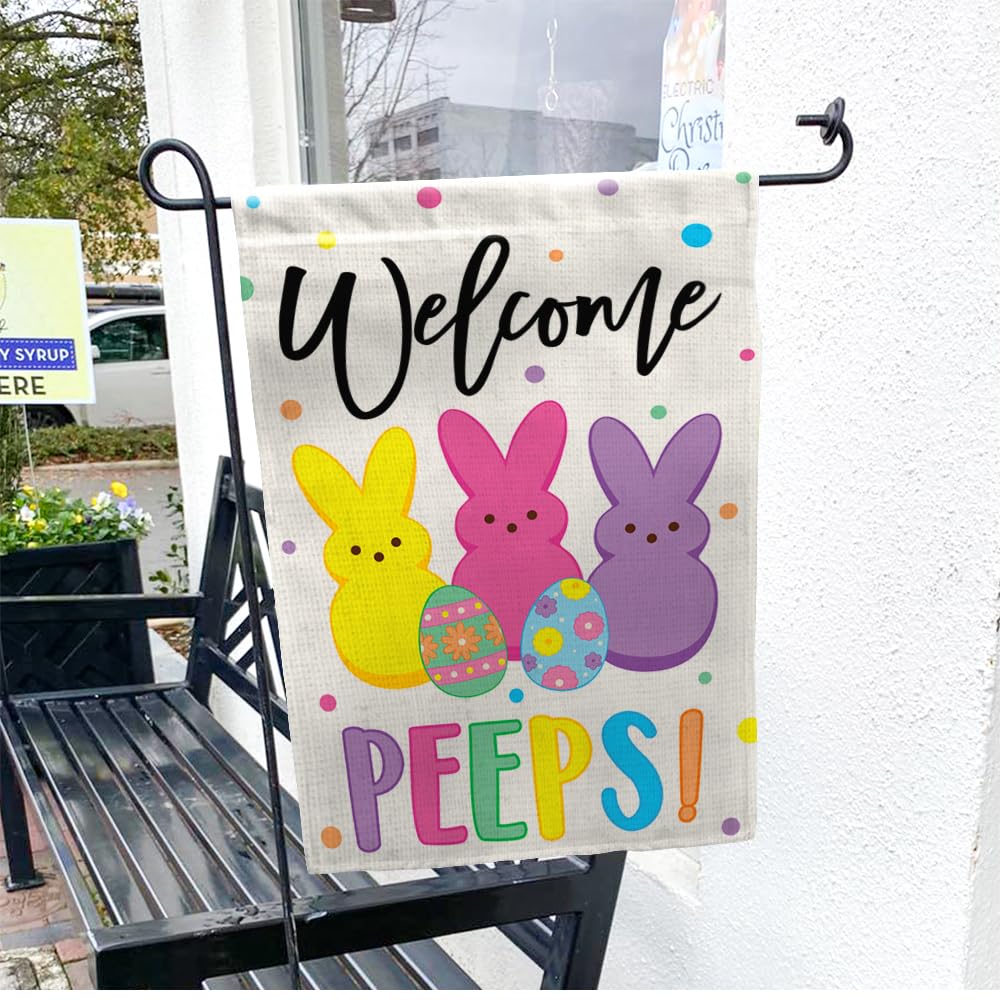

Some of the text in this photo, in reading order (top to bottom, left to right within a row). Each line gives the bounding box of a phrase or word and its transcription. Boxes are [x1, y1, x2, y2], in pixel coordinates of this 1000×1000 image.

[15, 348, 69, 362] SYRUP
[278, 234, 723, 420] Welcome
[342, 708, 706, 854] PEEPS!
